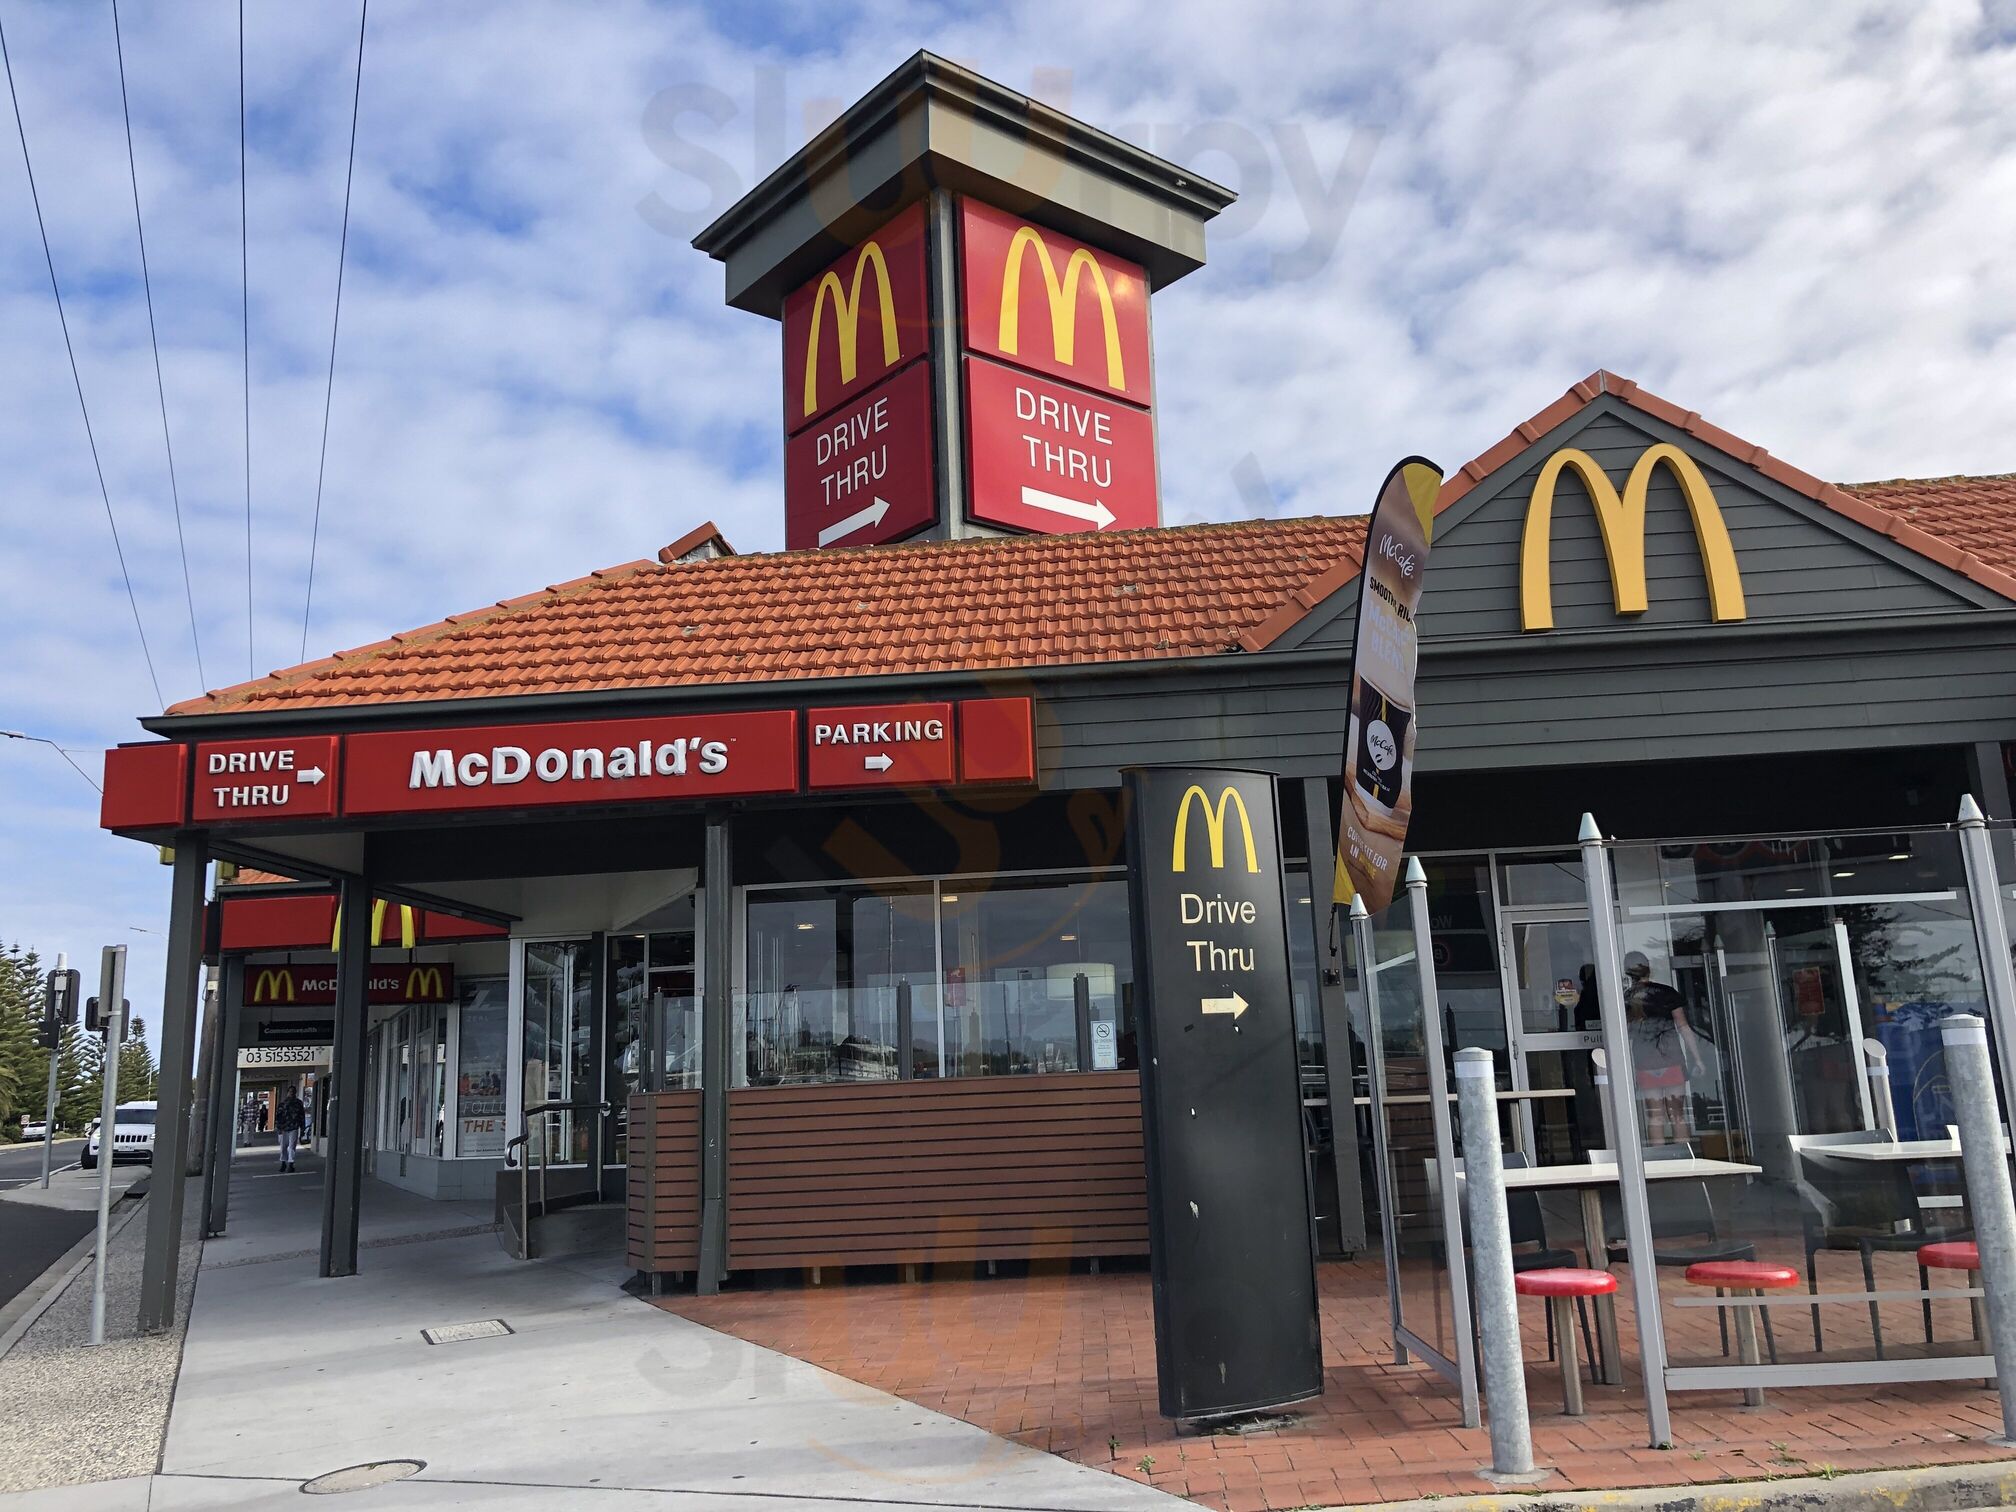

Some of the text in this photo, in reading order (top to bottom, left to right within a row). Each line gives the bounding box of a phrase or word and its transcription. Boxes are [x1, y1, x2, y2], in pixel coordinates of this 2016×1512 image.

[1015, 386, 1113, 446] DRIVE
[816, 395, 889, 467] DRIVE
[821, 444, 888, 508] THRU
[1022, 436, 1113, 489] THRU
[815, 719, 944, 746] PARKING
[208, 749, 295, 775] DRIVE
[409, 736, 731, 789] McDonald's
[214, 784, 289, 807] THRU
[1372, 853, 1388, 871] FOR
[1181, 893, 1256, 925] Drive
[1186, 940, 1255, 971] Thru
[302, 979, 399, 991] McDld's
[246, 1051, 315, 1063] 03 51553521
[464, 1120, 494, 1133] THE
